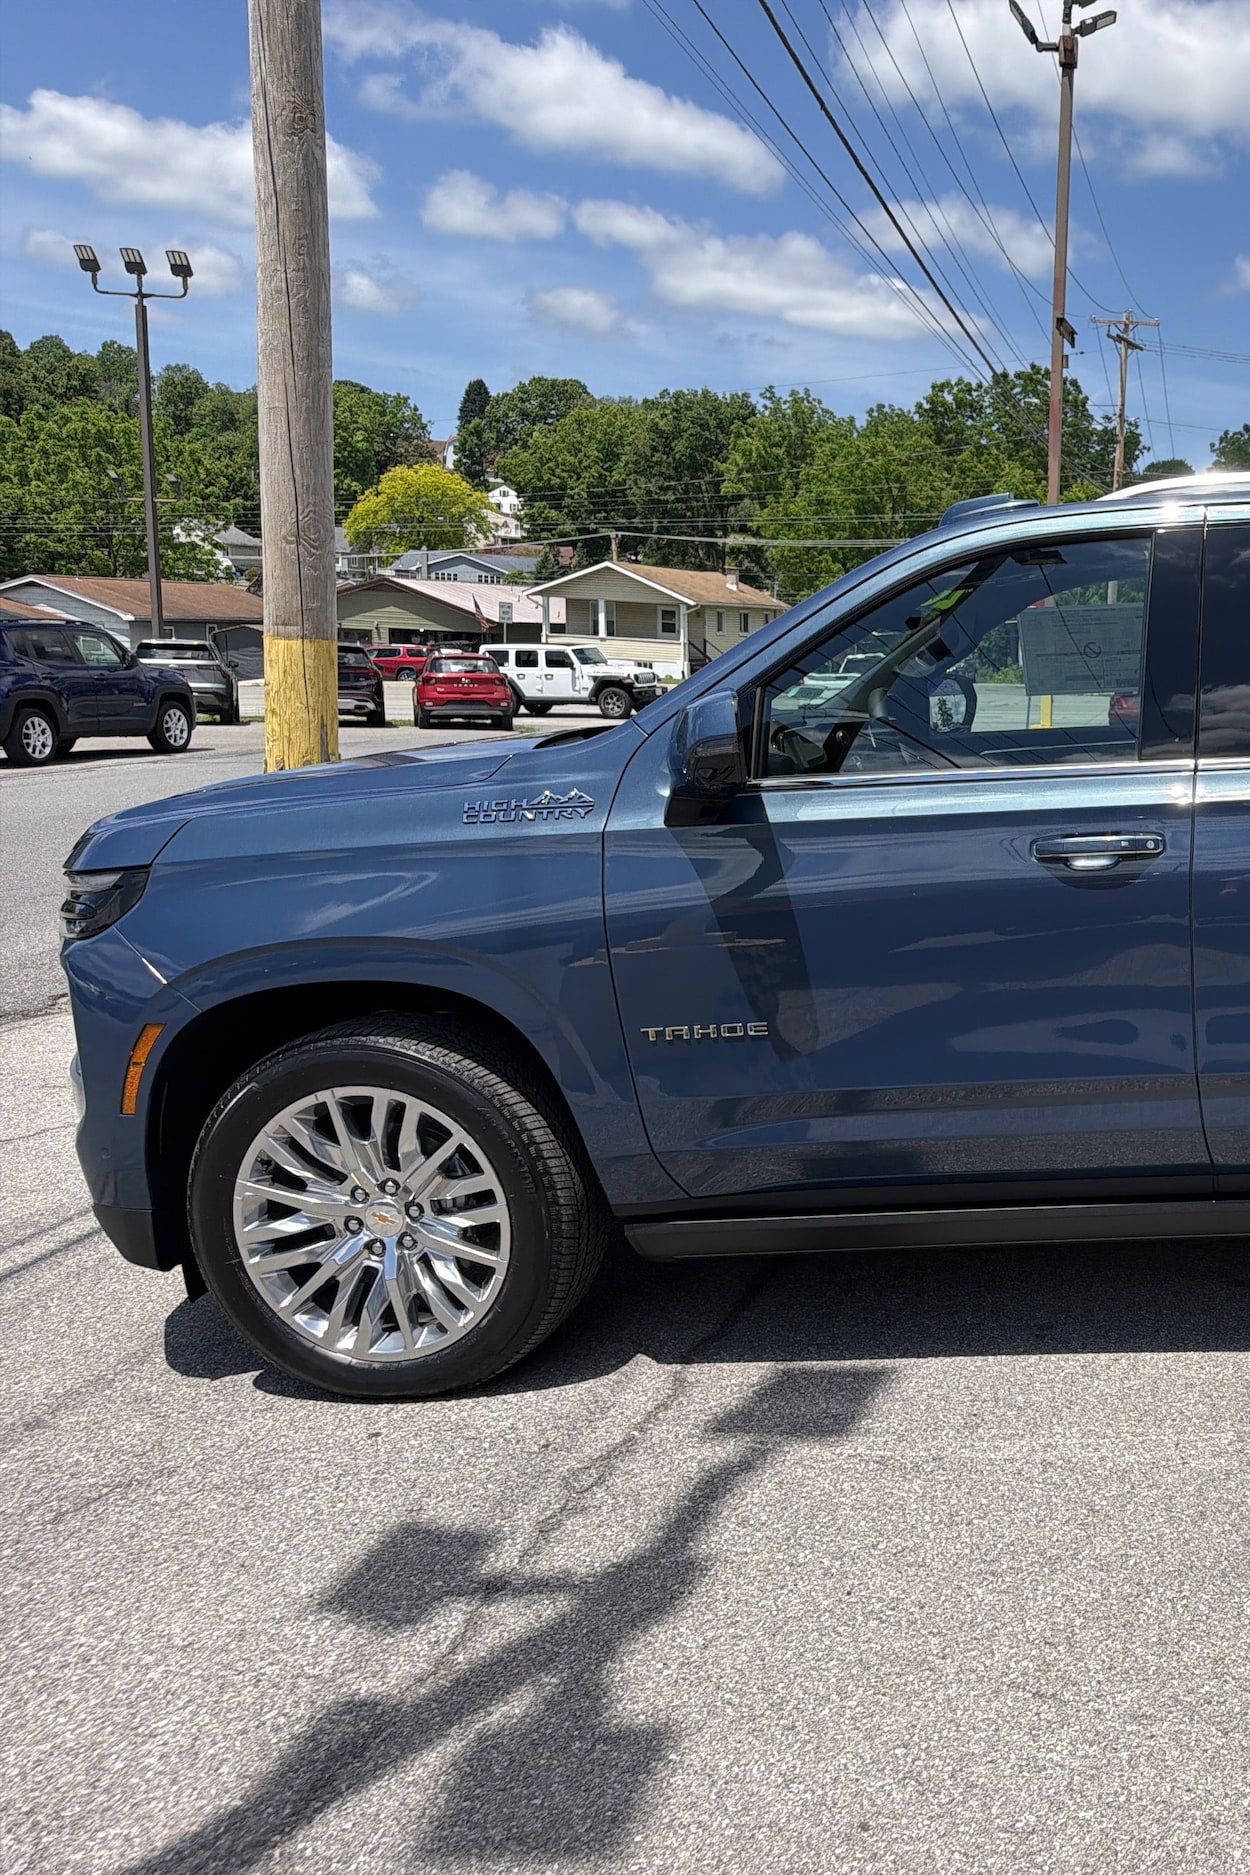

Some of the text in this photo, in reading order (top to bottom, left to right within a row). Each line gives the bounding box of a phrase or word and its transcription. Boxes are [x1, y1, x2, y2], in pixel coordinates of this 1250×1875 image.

[463, 799, 528, 813] HIGH
[462, 807, 594, 824] COUNTRY
[640, 1021, 769, 1042] TAHOE
